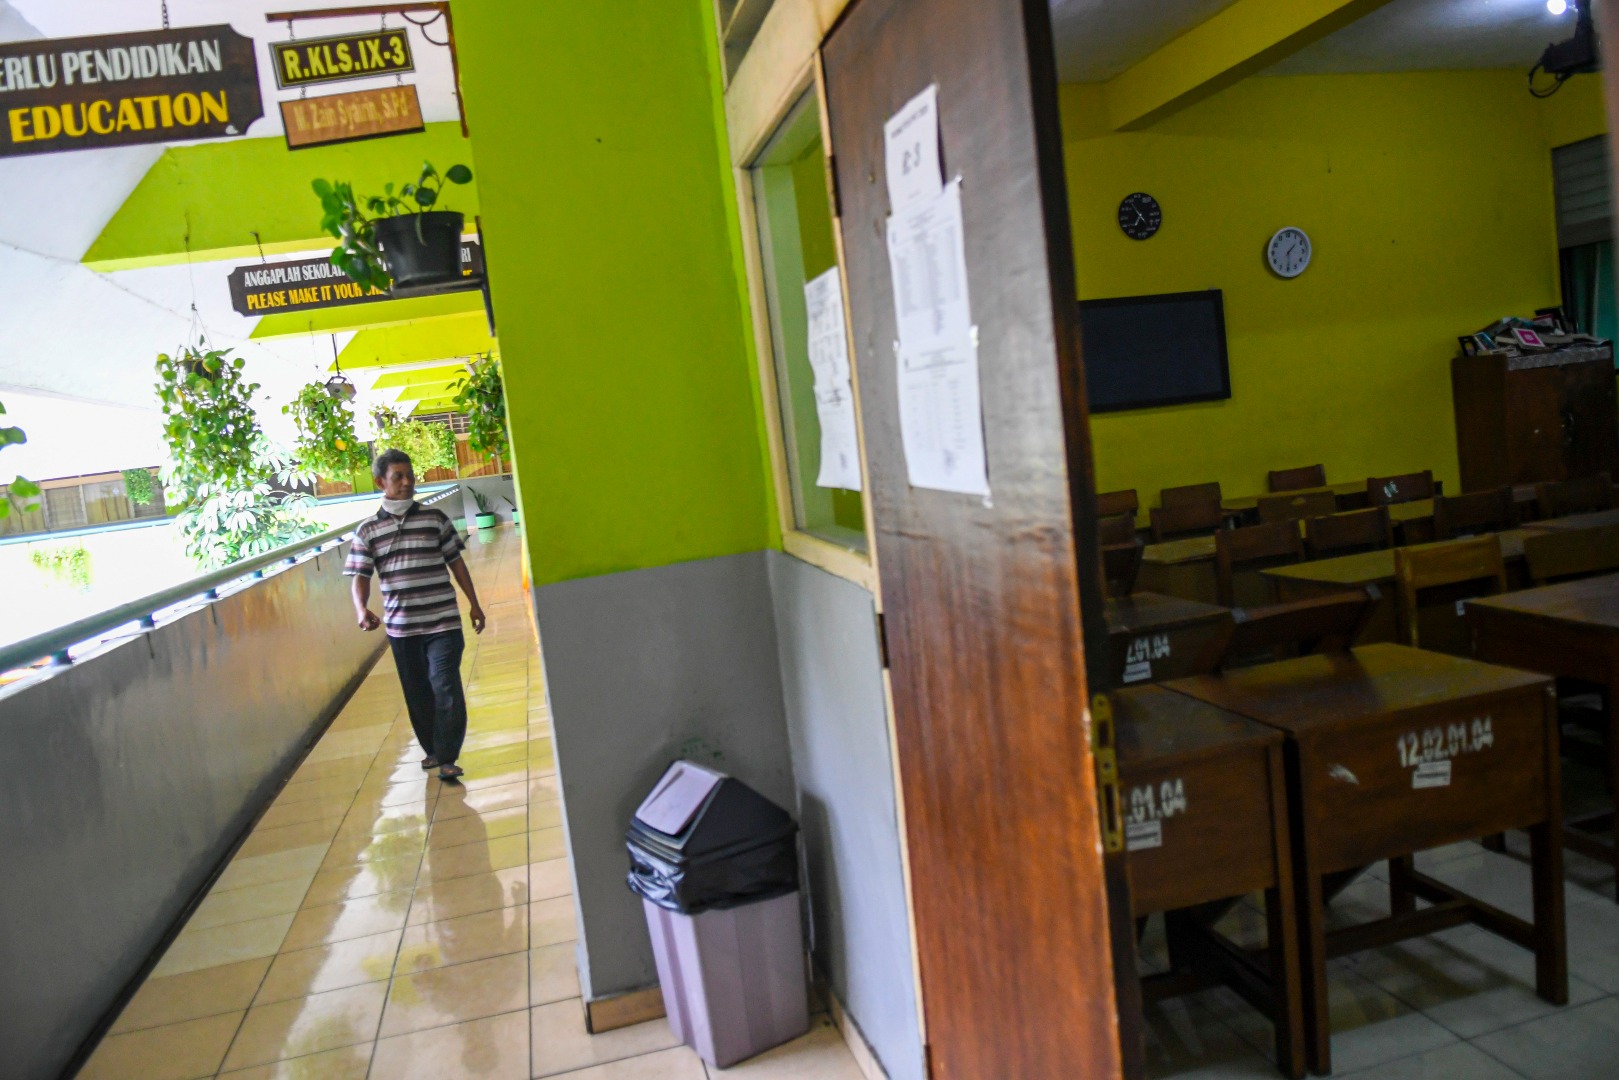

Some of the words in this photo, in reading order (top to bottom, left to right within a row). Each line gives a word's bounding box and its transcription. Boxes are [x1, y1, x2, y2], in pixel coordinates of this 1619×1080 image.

[61, 39, 223, 85] PENDIDIKAN
[282, 36, 405, 79] R.KLS.IX-3
[8, 90, 229, 142] EDUCATION
[244, 265, 302, 287] ANGGAPLAH
[302, 262, 346, 281] SEKOLA
[246, 291, 287, 310] PLEASE
[289, 286, 320, 304] MAKE
[321, 285, 331, 301] IT
[333, 282, 363, 299] YOUR
[1124, 778, 1187, 823] .01.04
